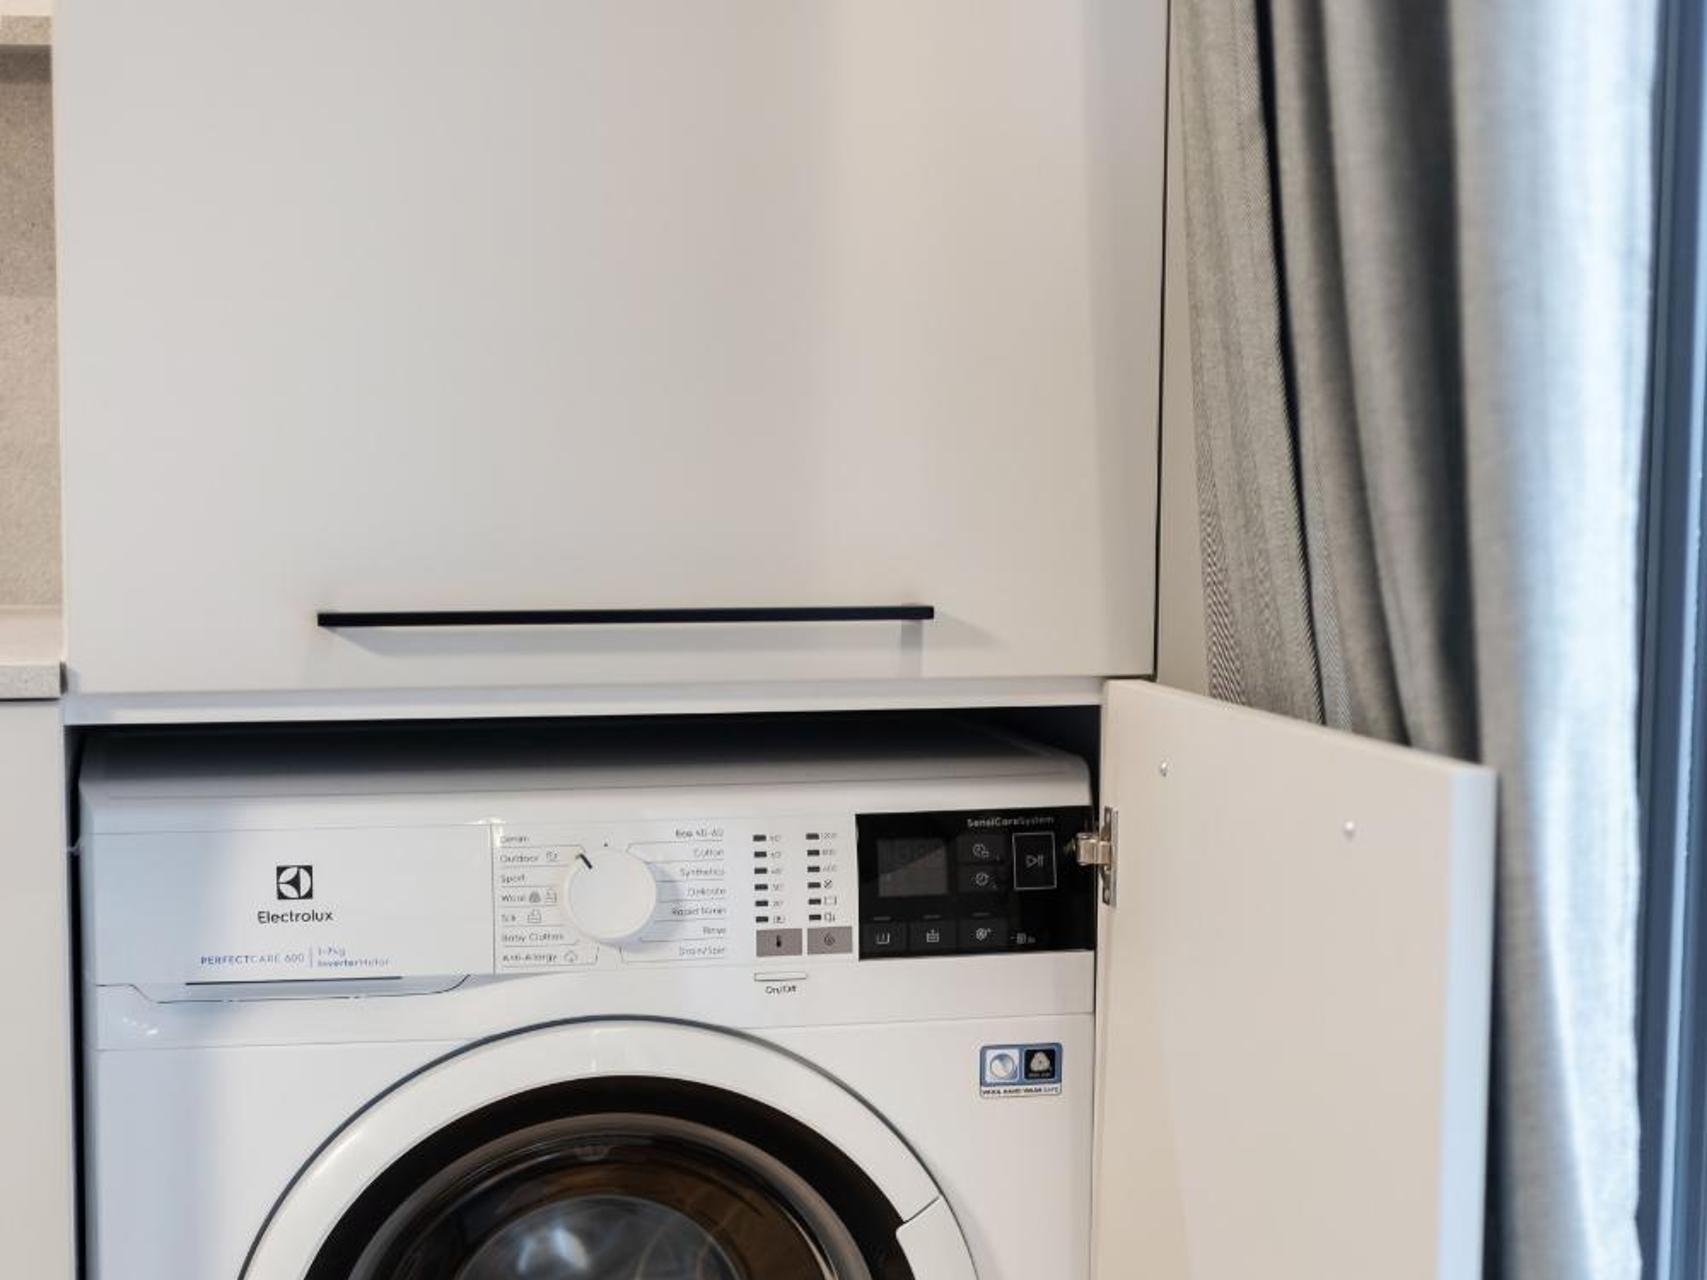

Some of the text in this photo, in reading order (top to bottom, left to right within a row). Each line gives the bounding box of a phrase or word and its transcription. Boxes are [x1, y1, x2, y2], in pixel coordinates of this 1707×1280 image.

[257, 909, 334, 924] Electrolux
[201, 953, 305, 965] PERFECTCARE 600
